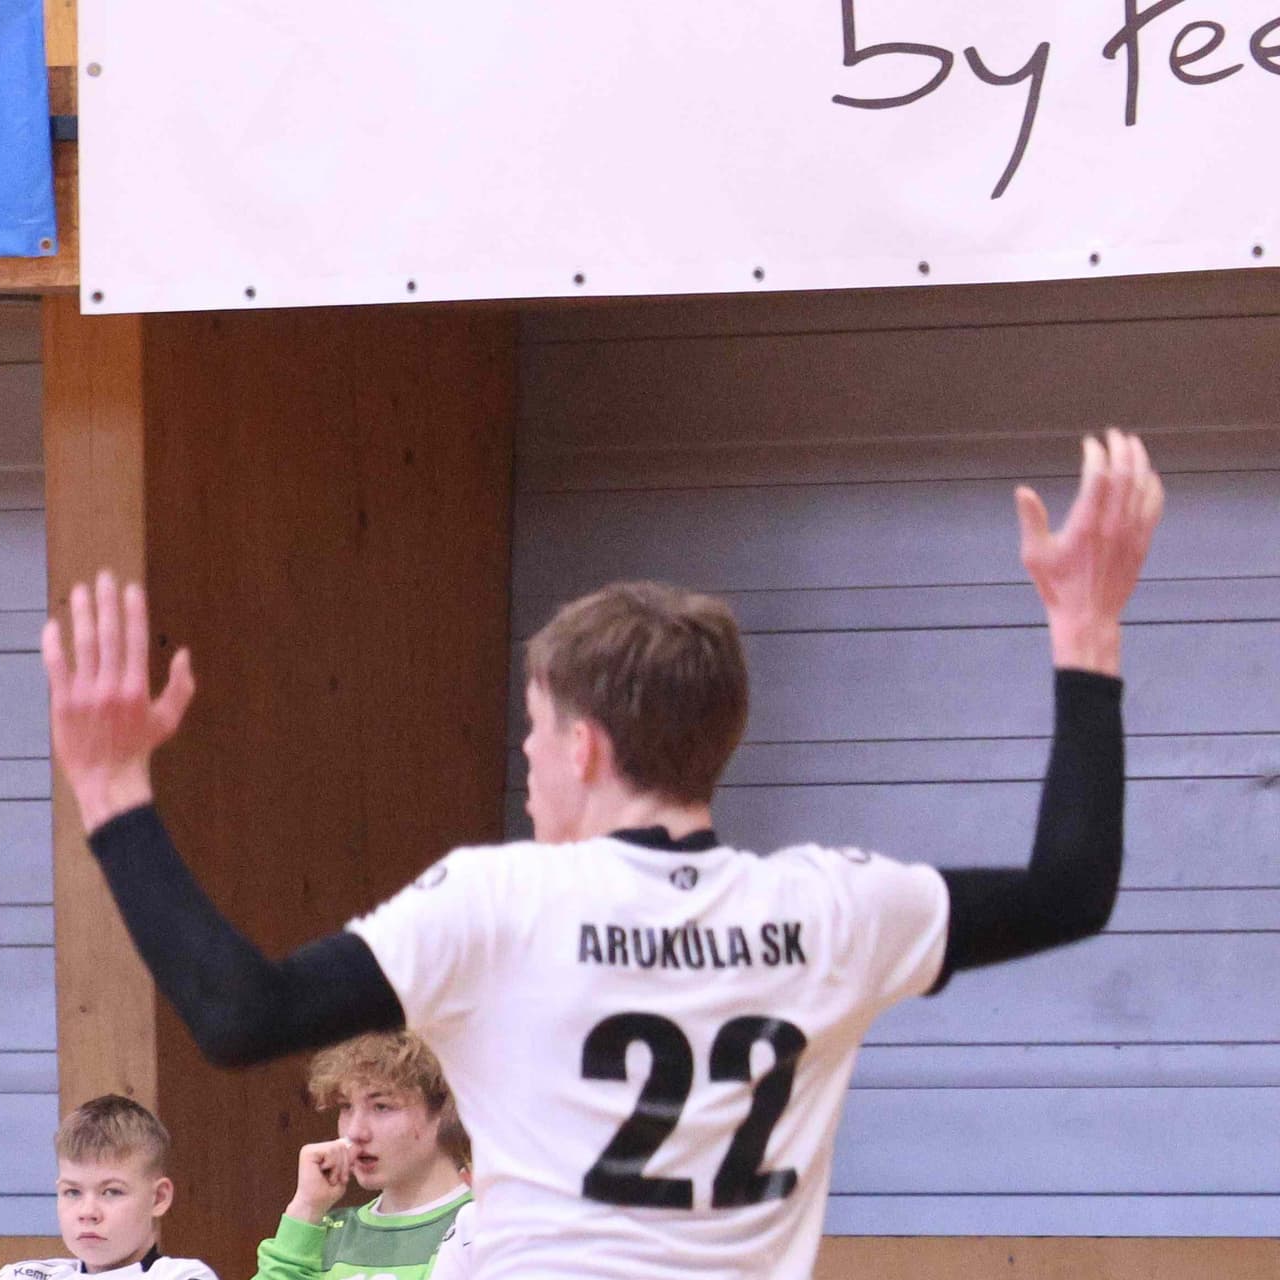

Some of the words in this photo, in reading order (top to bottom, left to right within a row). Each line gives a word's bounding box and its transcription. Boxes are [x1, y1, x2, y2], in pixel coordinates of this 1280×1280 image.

[831, 0, 1051, 200] by
[760, 921, 807, 967] SK
[580, 1011, 808, 1211] 22
